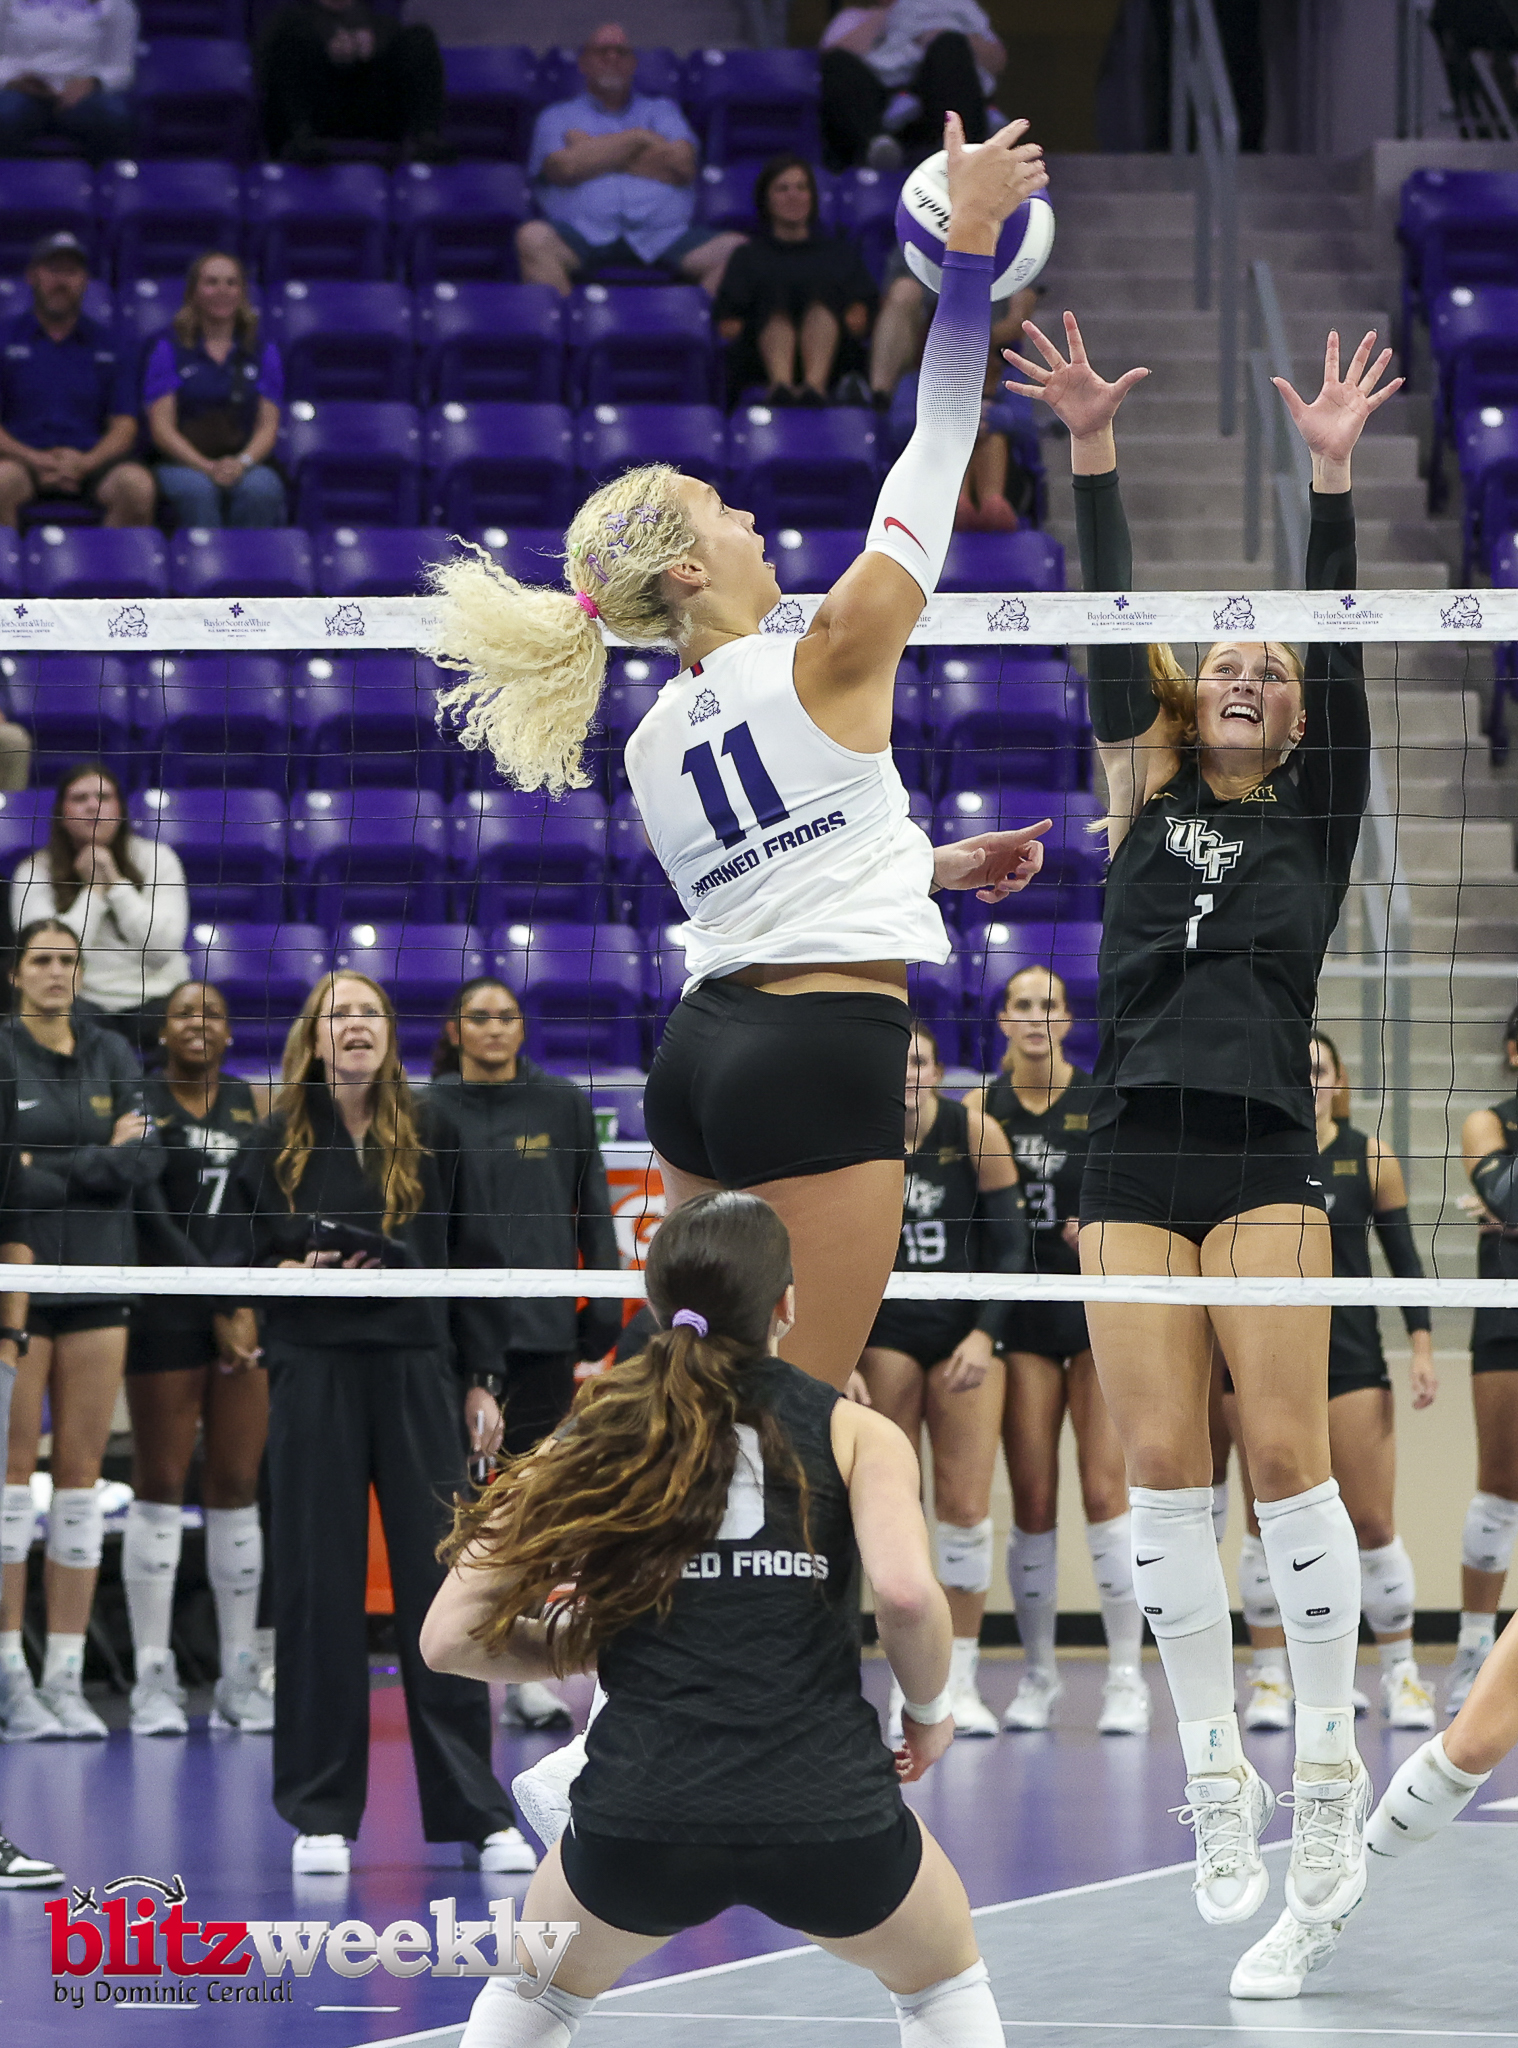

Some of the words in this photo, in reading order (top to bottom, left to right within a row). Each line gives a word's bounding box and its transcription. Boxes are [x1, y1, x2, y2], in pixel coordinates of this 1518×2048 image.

[681, 720, 790, 850] 11
[762, 810, 847, 859] FROGS
[1165, 816, 1244, 884] UCF
[1185, 893, 1214, 949] 1
[198, 1166, 230, 1217] 7
[1025, 1182, 1057, 1230] 3
[902, 1220, 947, 1264] 19
[733, 1550, 829, 1580] FROGS
